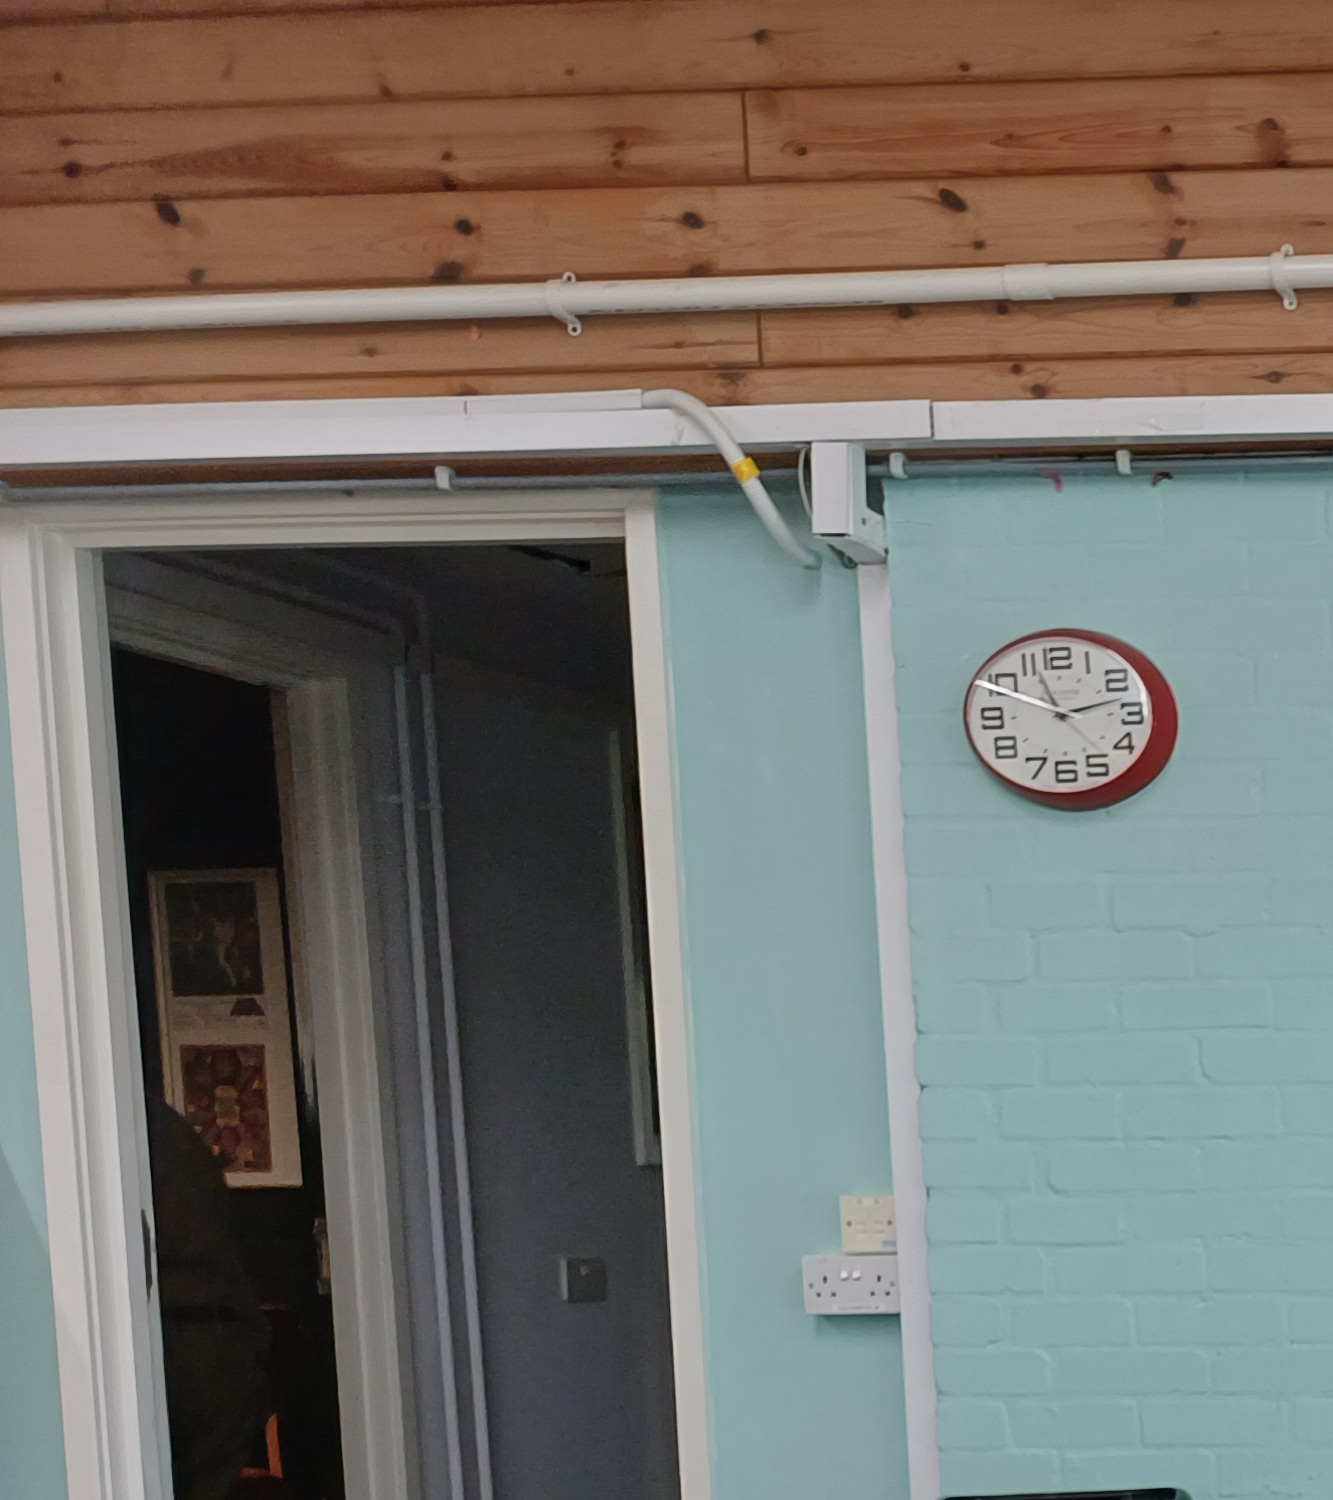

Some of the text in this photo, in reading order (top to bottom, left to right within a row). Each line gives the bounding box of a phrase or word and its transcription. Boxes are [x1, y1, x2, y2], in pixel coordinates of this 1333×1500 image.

[1021, 652, 1037, 677] 11
[1042, 646, 1073, 671] 12
[1104, 668, 1129, 692] 2
[980, 706, 1004, 730] 9
[1120, 701, 1144, 726] 3
[994, 736, 1018, 759] 8
[1112, 732, 1135, 754] 4
[1025, 756, 1048, 780] 7
[1054, 760, 1078, 783] 6
[1085, 754, 1109, 777] 5
